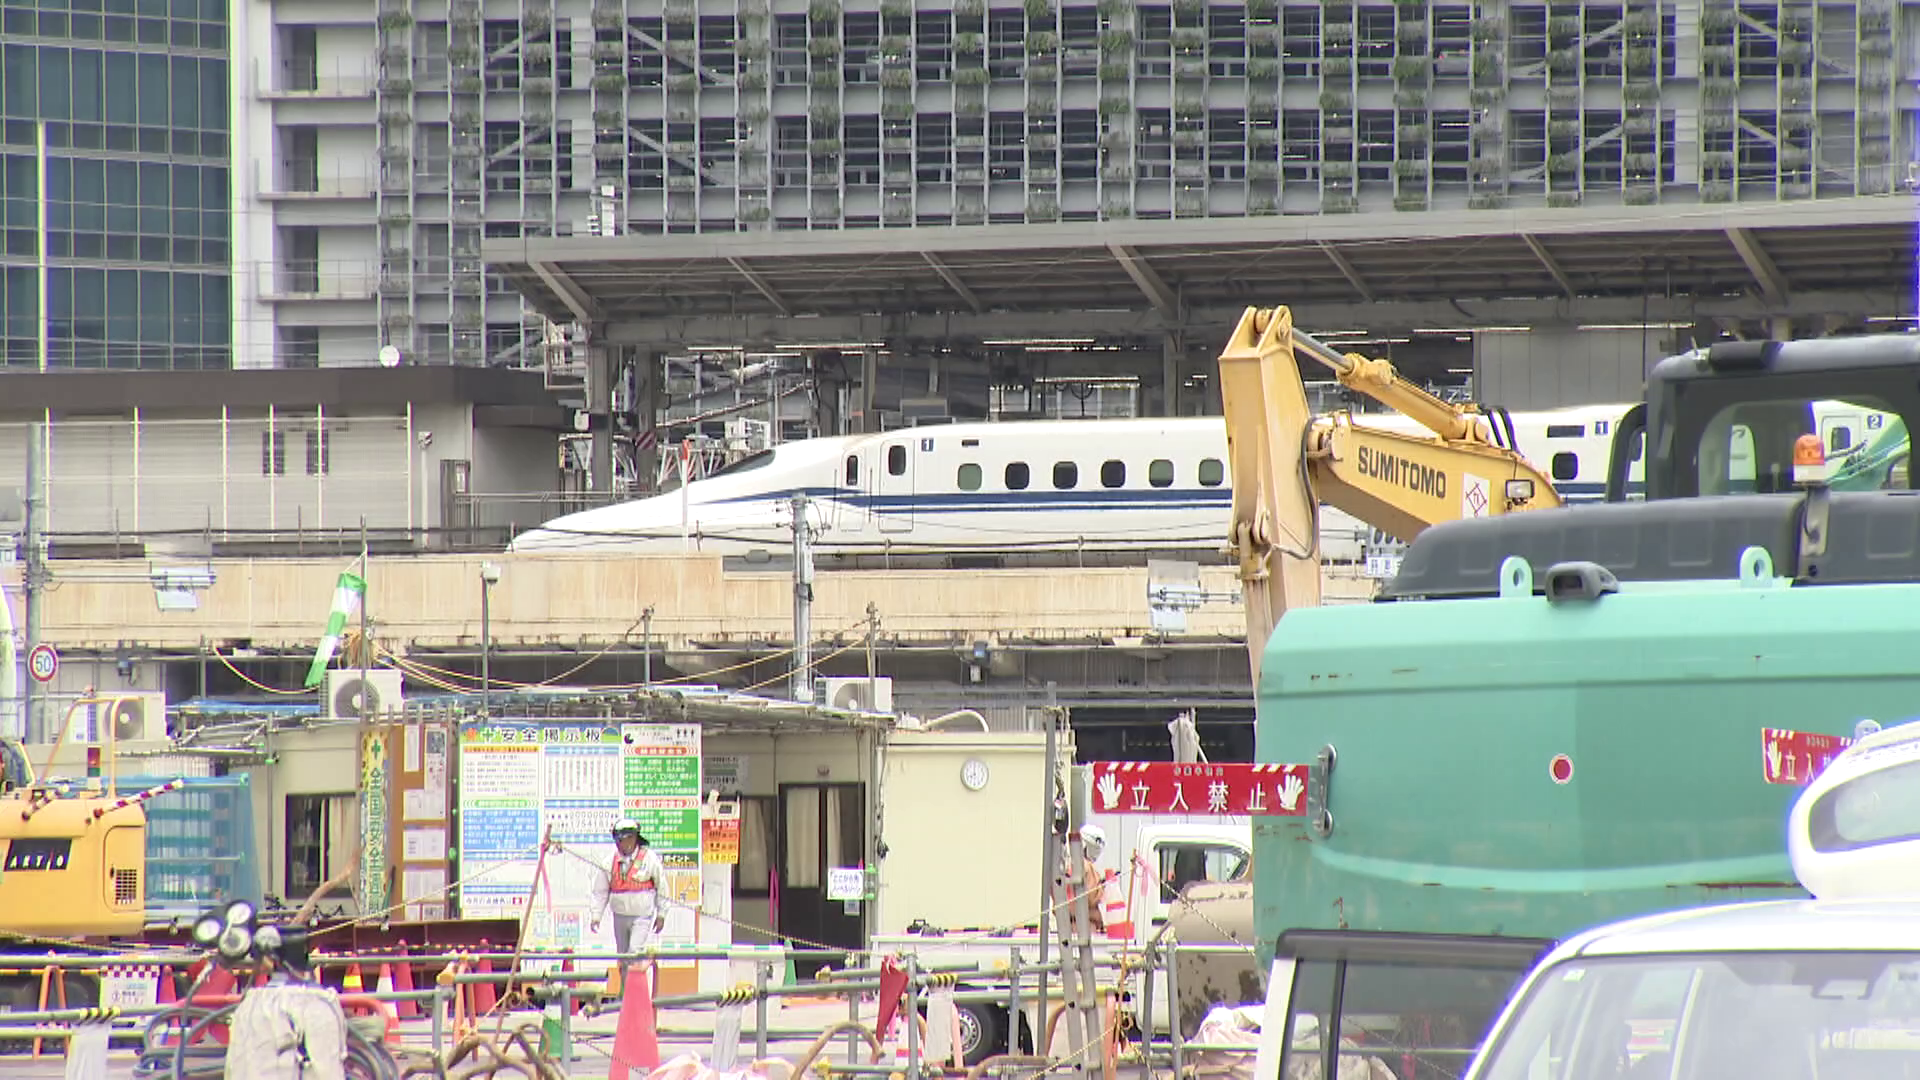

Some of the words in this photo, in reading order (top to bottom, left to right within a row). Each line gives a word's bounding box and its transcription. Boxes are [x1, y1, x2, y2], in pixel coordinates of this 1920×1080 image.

[1358, 445, 1446, 499] SUMITOMO
[35, 655, 52, 673] 50
[501, 727, 601, 743] 安全掲示板
[1130, 780, 1268, 812] 立入禁止
